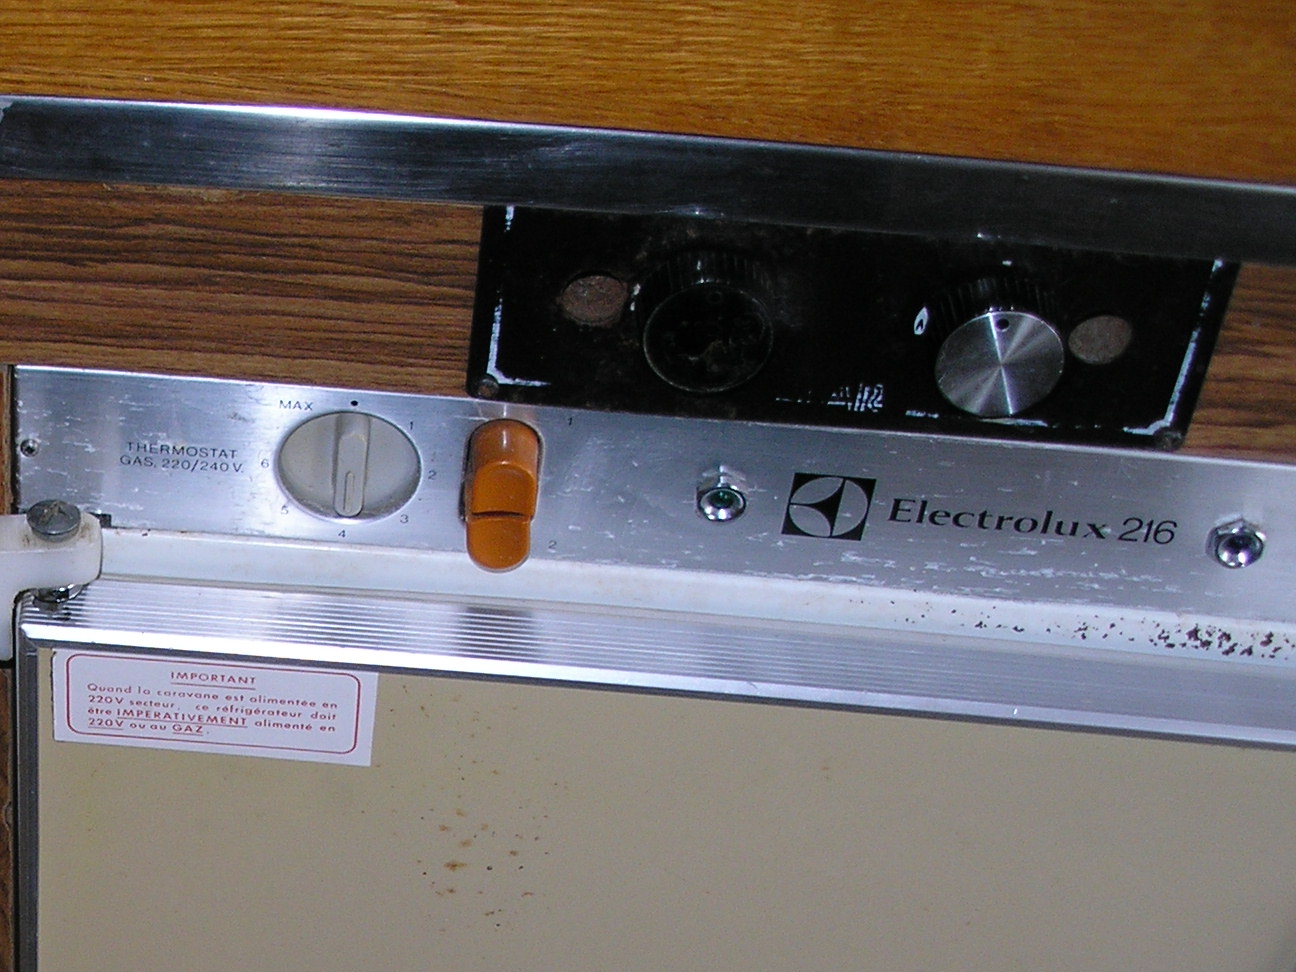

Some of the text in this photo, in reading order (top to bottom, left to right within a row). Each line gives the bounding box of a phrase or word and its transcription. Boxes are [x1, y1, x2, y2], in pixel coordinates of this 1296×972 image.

[279, 400, 313, 411] MAX
[127, 442, 237, 459] THERMOSTAT
[261, 459, 270, 468] 6
[428, 470, 437, 480] 2
[281, 505, 289, 515] 5
[400, 514, 408, 523] 3
[888, 498, 1178, 545] Electrolux 216
[338, 530, 346, 538] 4
[548, 540, 557, 549] 2
[170, 671, 256, 685] IMPORTANT
[87, 683, 132, 694] Quand
[138, 686, 151, 695] la
[157, 690, 219, 700] caravane
[249, 695, 316, 707] alimentée
[216, 704, 302, 718] réfrigérateur
[310, 711, 337, 720] doit
[117, 708, 247, 726] IMPERATIVEMENT
[254, 720, 313, 731] alimenté
